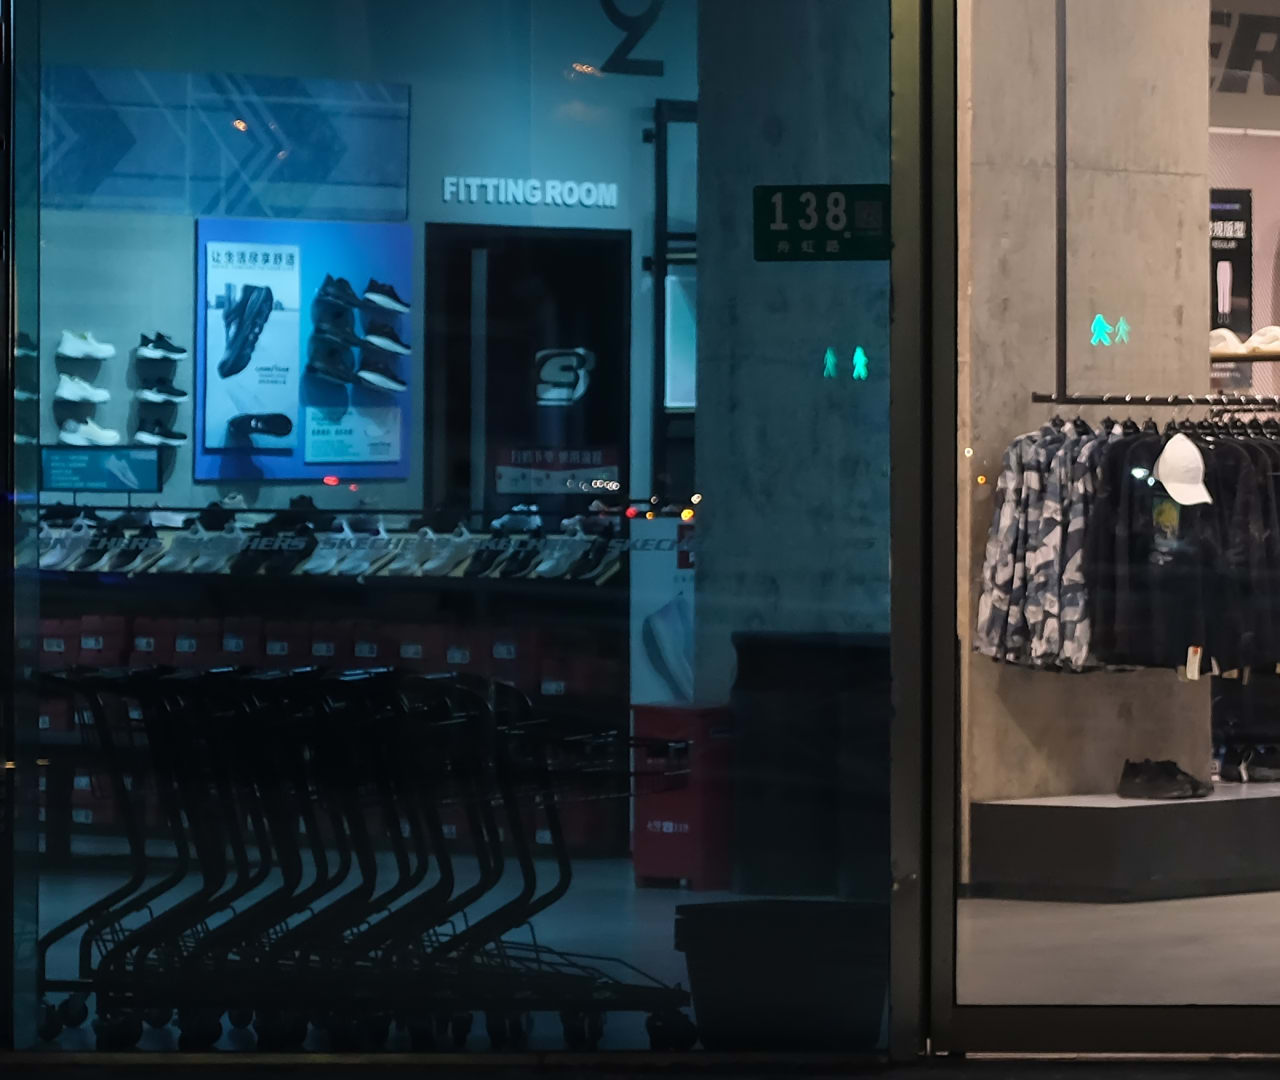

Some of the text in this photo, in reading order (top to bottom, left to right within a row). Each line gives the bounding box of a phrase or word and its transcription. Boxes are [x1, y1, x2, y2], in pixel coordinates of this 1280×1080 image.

[443, 176, 618, 208] FITTING ROOM
[769, 191, 848, 232] 138
